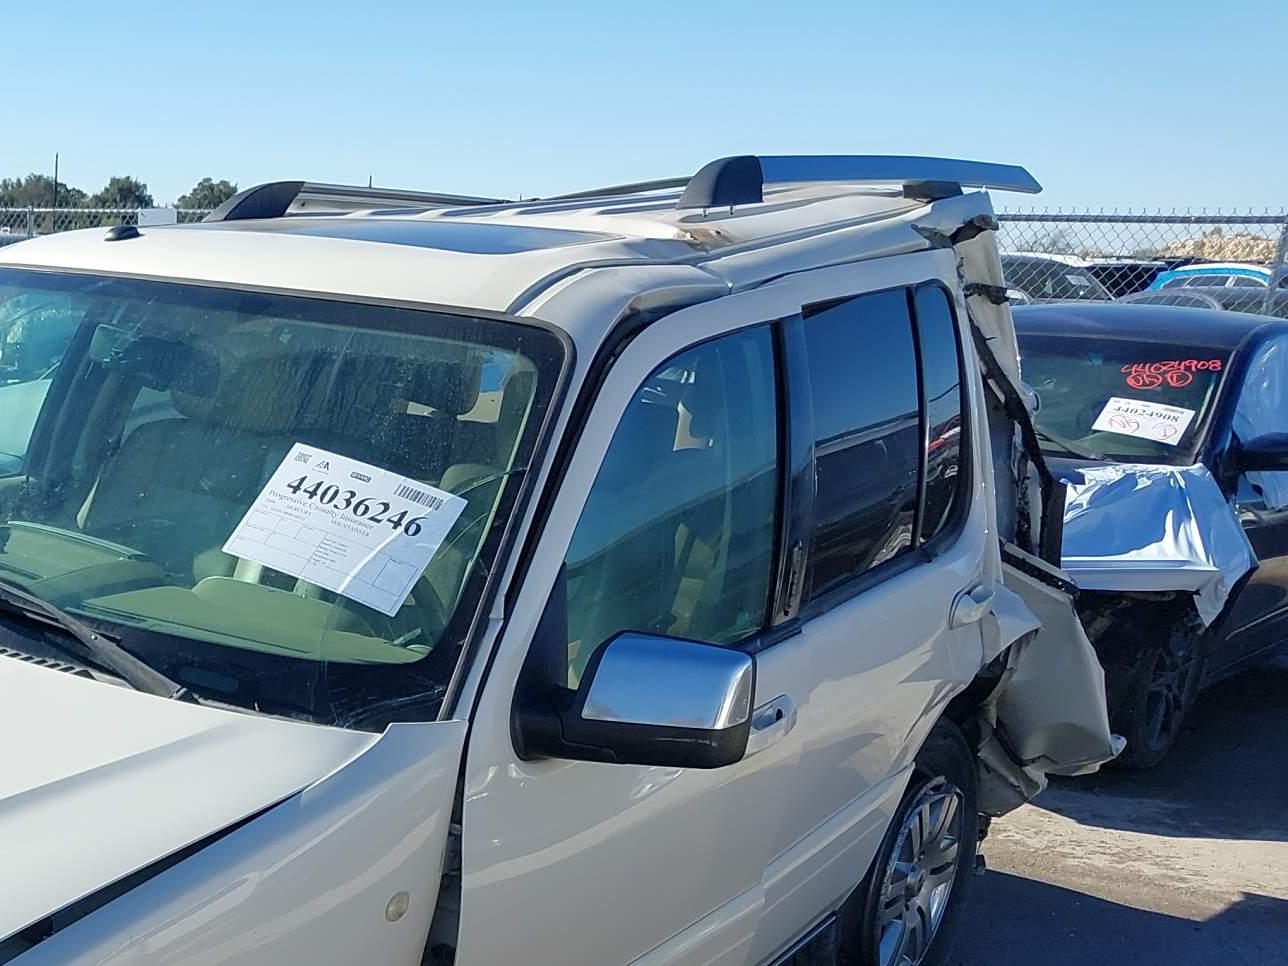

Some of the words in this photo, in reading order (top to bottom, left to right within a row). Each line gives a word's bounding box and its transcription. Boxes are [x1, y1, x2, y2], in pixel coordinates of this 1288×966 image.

[1121, 359, 1222, 374] 44024908
[1113, 405, 1180, 423] 44024908
[268, 489, 309, 507] Progressive
[309, 502, 338, 518] Casualty
[339, 513, 374, 530] Insurance
[286, 474, 431, 537] 44036246
